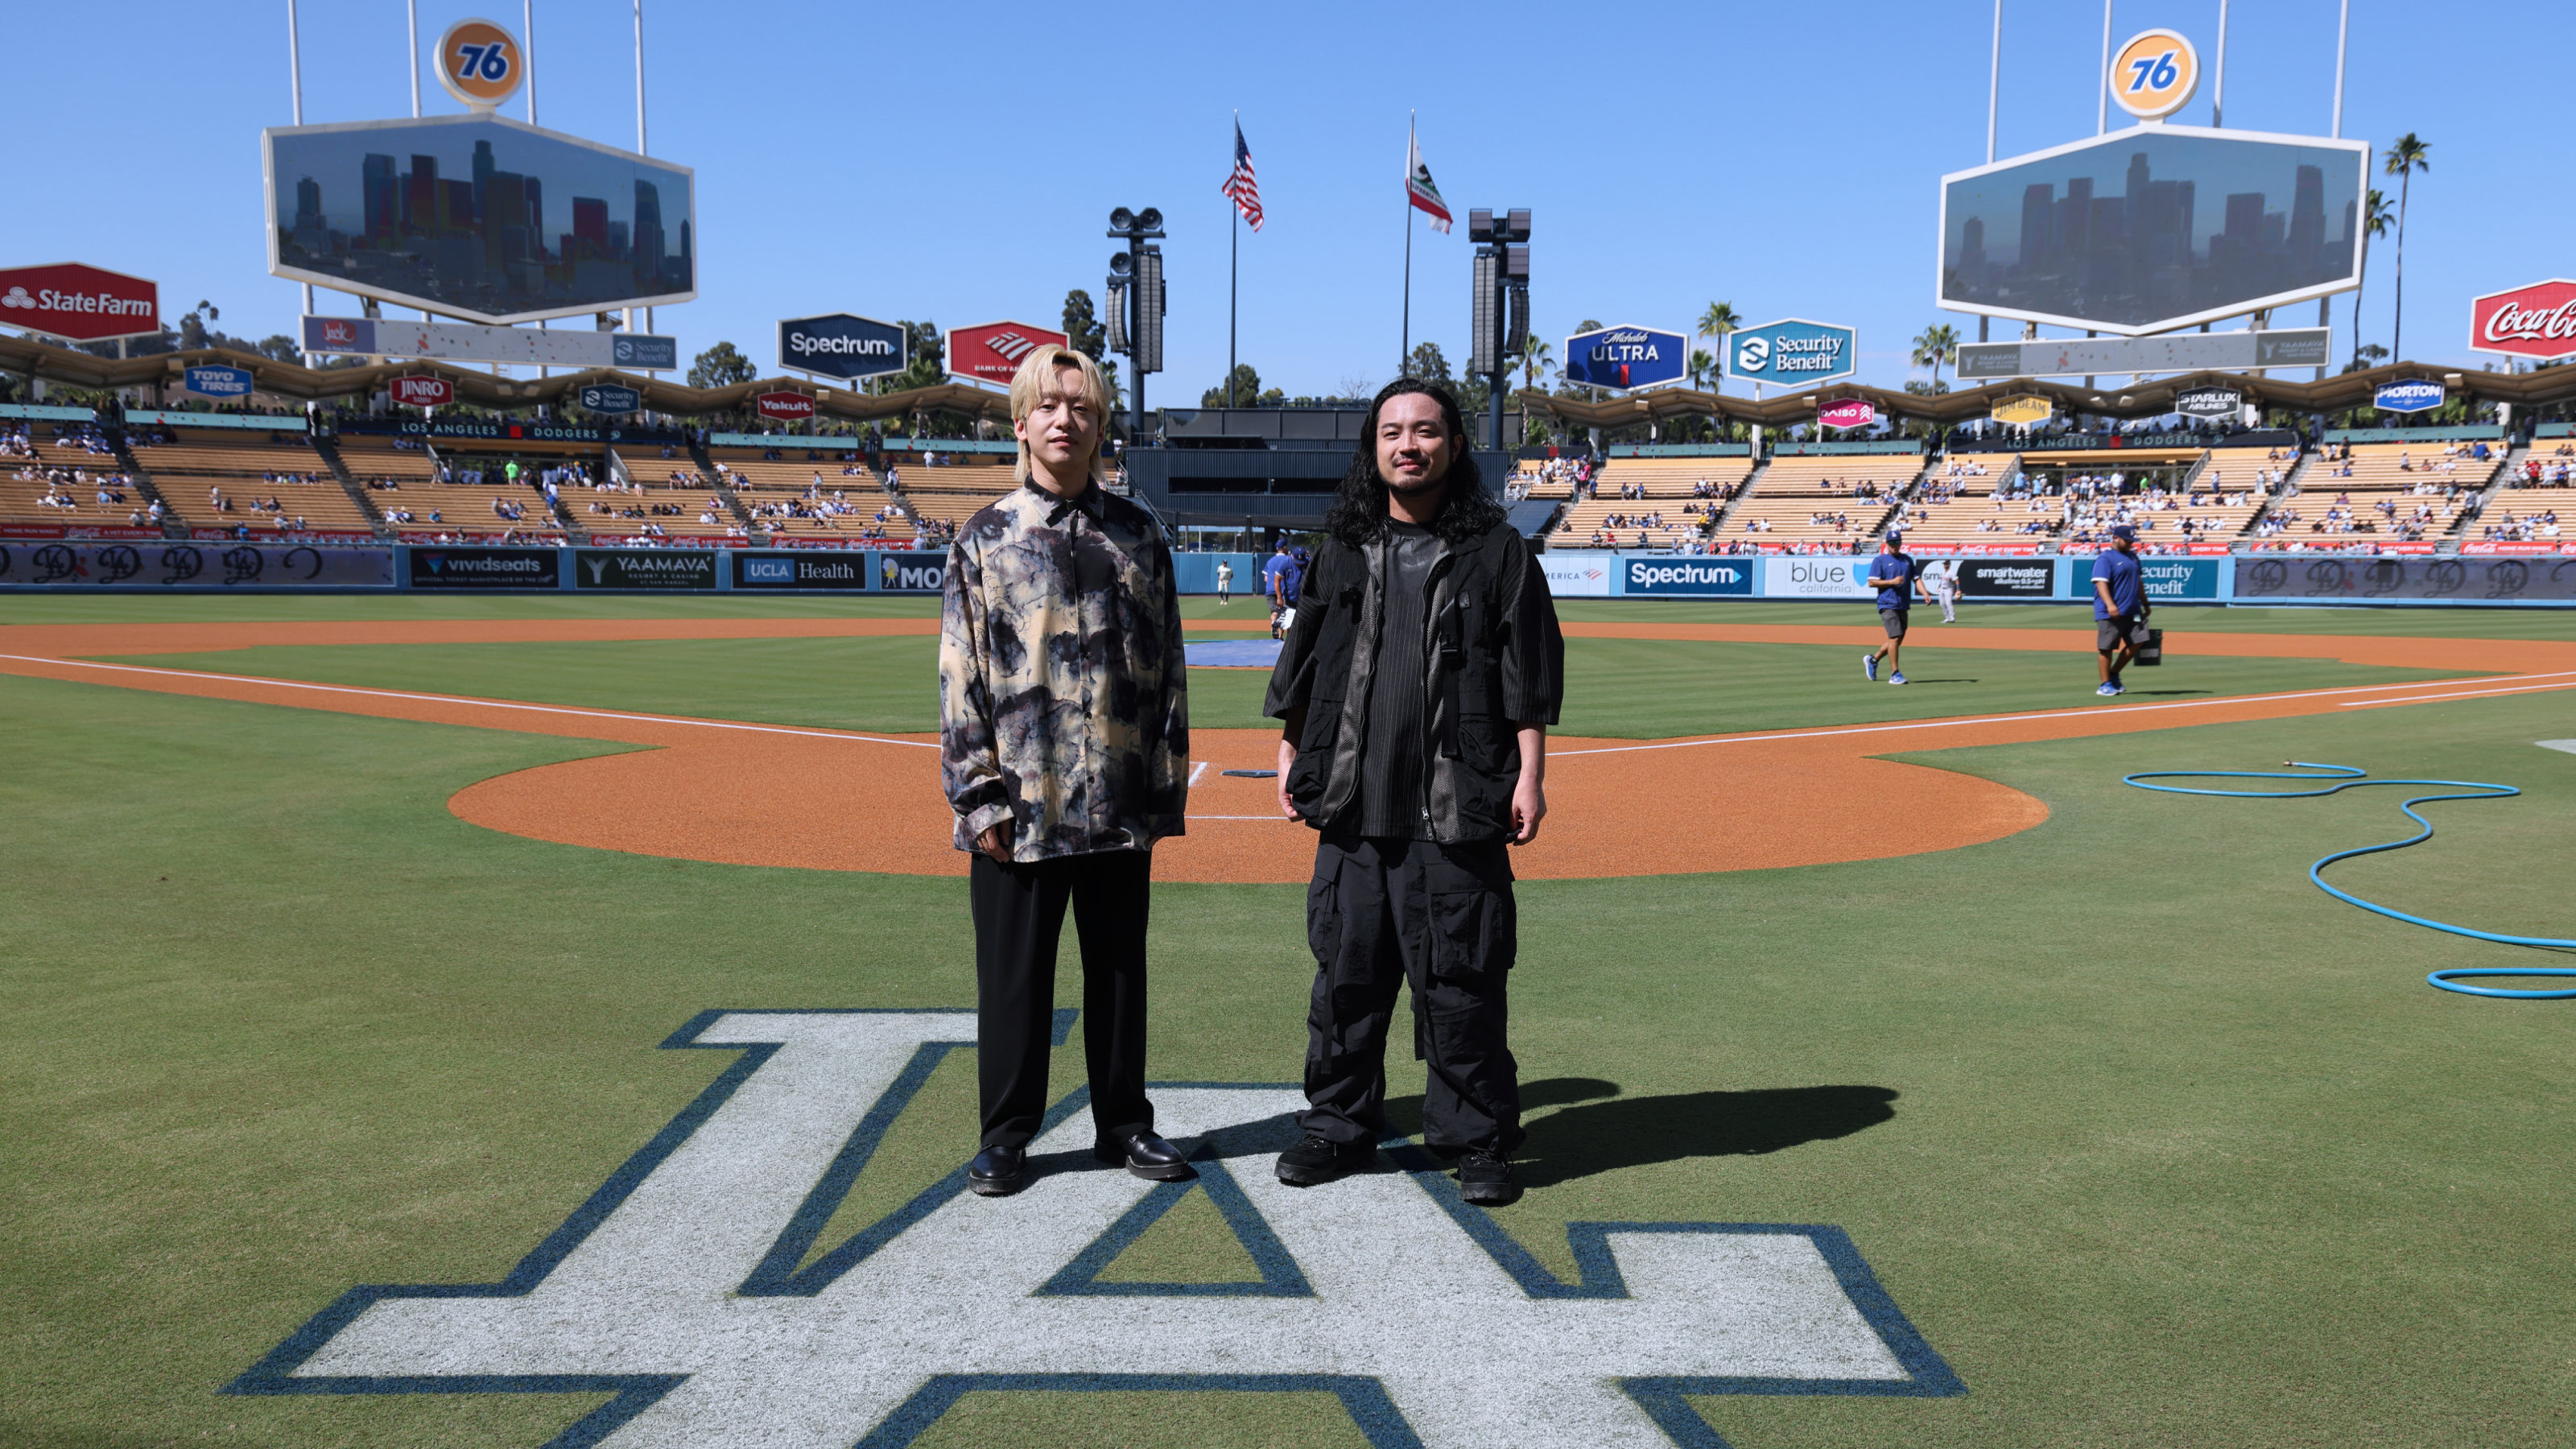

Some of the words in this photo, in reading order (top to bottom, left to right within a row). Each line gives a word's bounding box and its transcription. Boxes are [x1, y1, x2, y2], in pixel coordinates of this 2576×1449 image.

[456, 41, 510, 83] 76
[2125, 48, 2181, 94] 76
[791, 332, 889, 357] Spectrum
[1603, 332, 1649, 345] Michelob
[1776, 334, 1843, 354] Security
[636, 342, 671, 353] Security
[1592, 345, 1659, 361] ULTRA
[636, 352, 667, 362] Benefit
[1776, 353, 1832, 370] Benefit
[192, 370, 235, 382] TOYO
[200, 381, 245, 392] TIRES
[401, 380, 444, 398] JINRO
[2378, 385, 2442, 398] MORTON
[603, 390, 634, 401] Security
[2180, 393, 2236, 404] STARLUX
[604, 399, 630, 409] Benefit
[762, 400, 811, 411] Yakult
[2187, 402, 2228, 411] AIRLINES
[1821, 409, 1856, 417] DAISO
[402, 423, 427, 432] LOS
[434, 424, 497, 436] ANGELES
[535, 427, 598, 439] DODGERS
[2007, 440, 2030, 448] LOS
[2036, 437, 2097, 448] ANGELES
[2134, 435, 2200, 445] DODGERS
[751, 564, 789, 577] UCLA
[799, 564, 855, 578] Health
[1631, 563, 1734, 588] Spectrum
[1791, 562, 1845, 583] blue
[1976, 567, 2048, 578] smartwater
[2140, 563, 2194, 581] ecurity
[900, 568, 943, 589] MO
[1799, 583, 1852, 593] california
[2143, 580, 2185, 594] enefit
